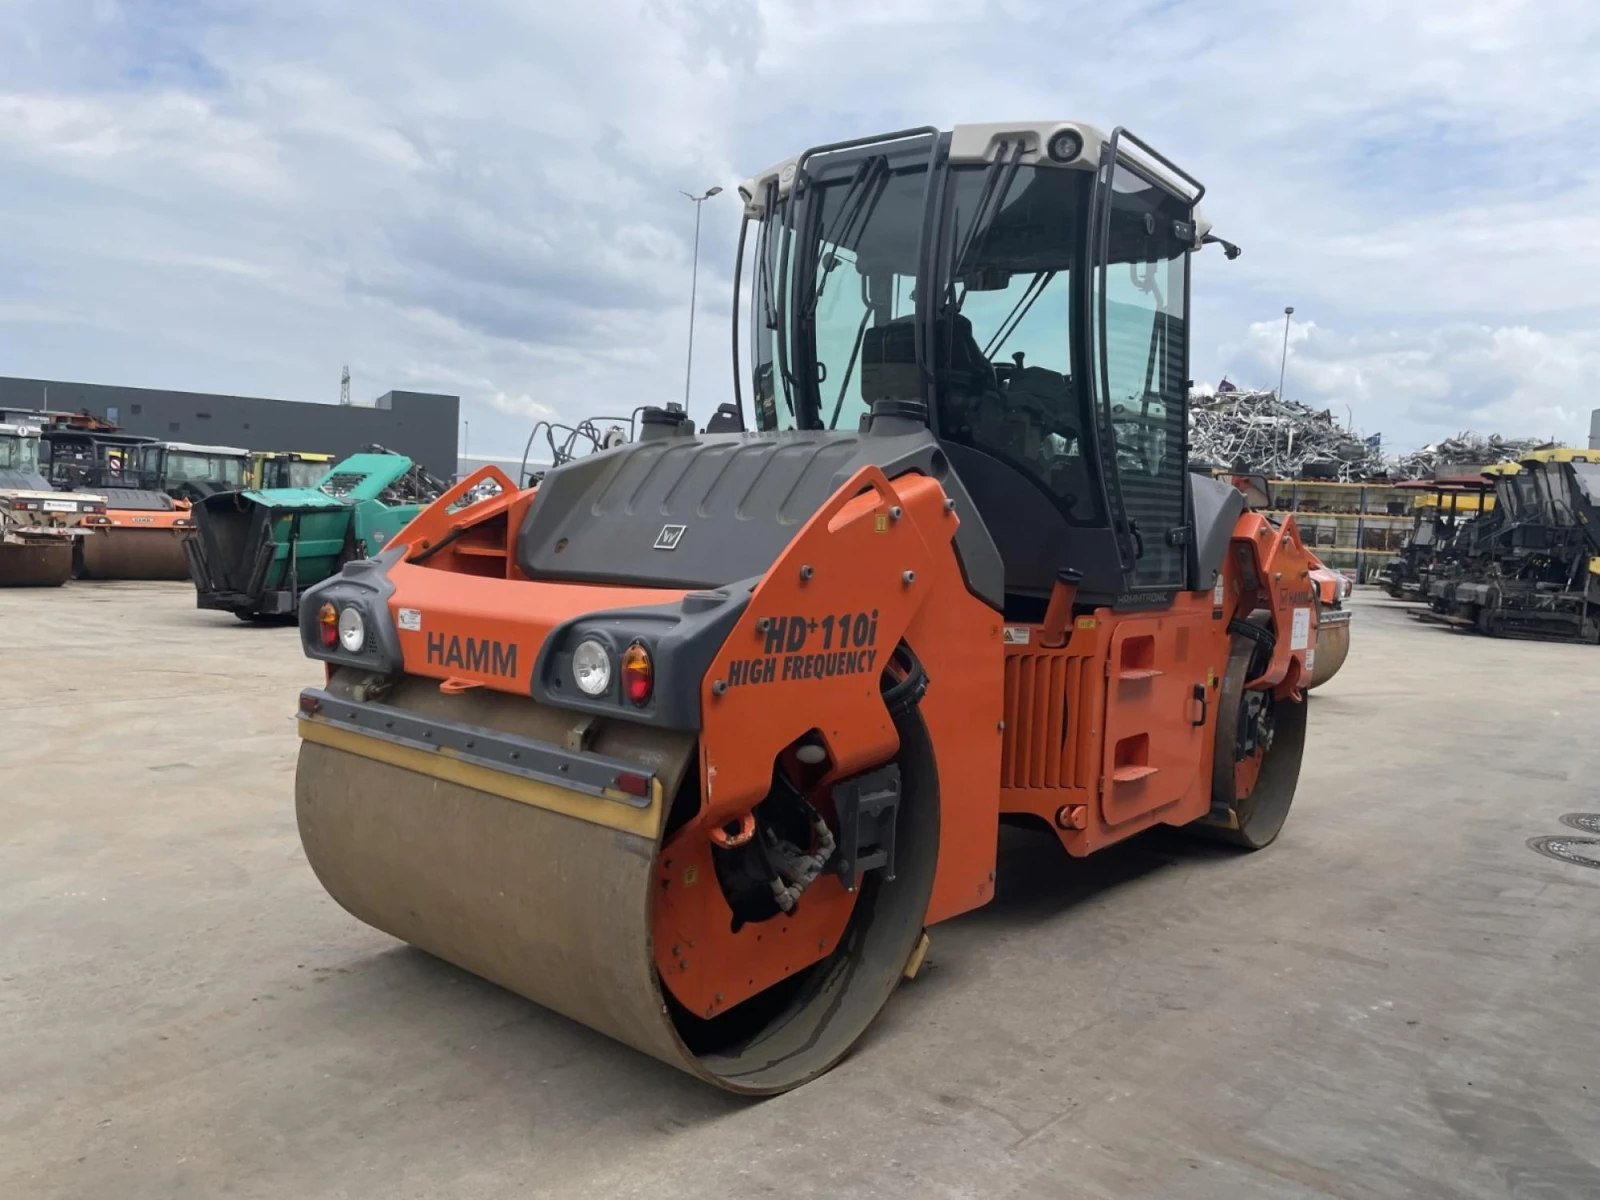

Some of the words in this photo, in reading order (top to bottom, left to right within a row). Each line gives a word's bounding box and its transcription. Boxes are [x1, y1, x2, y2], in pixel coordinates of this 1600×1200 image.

[428, 632, 517, 678] HAMM
[728, 657, 776, 686] HIGH
[782, 650, 876, 680] FREQUENCY
